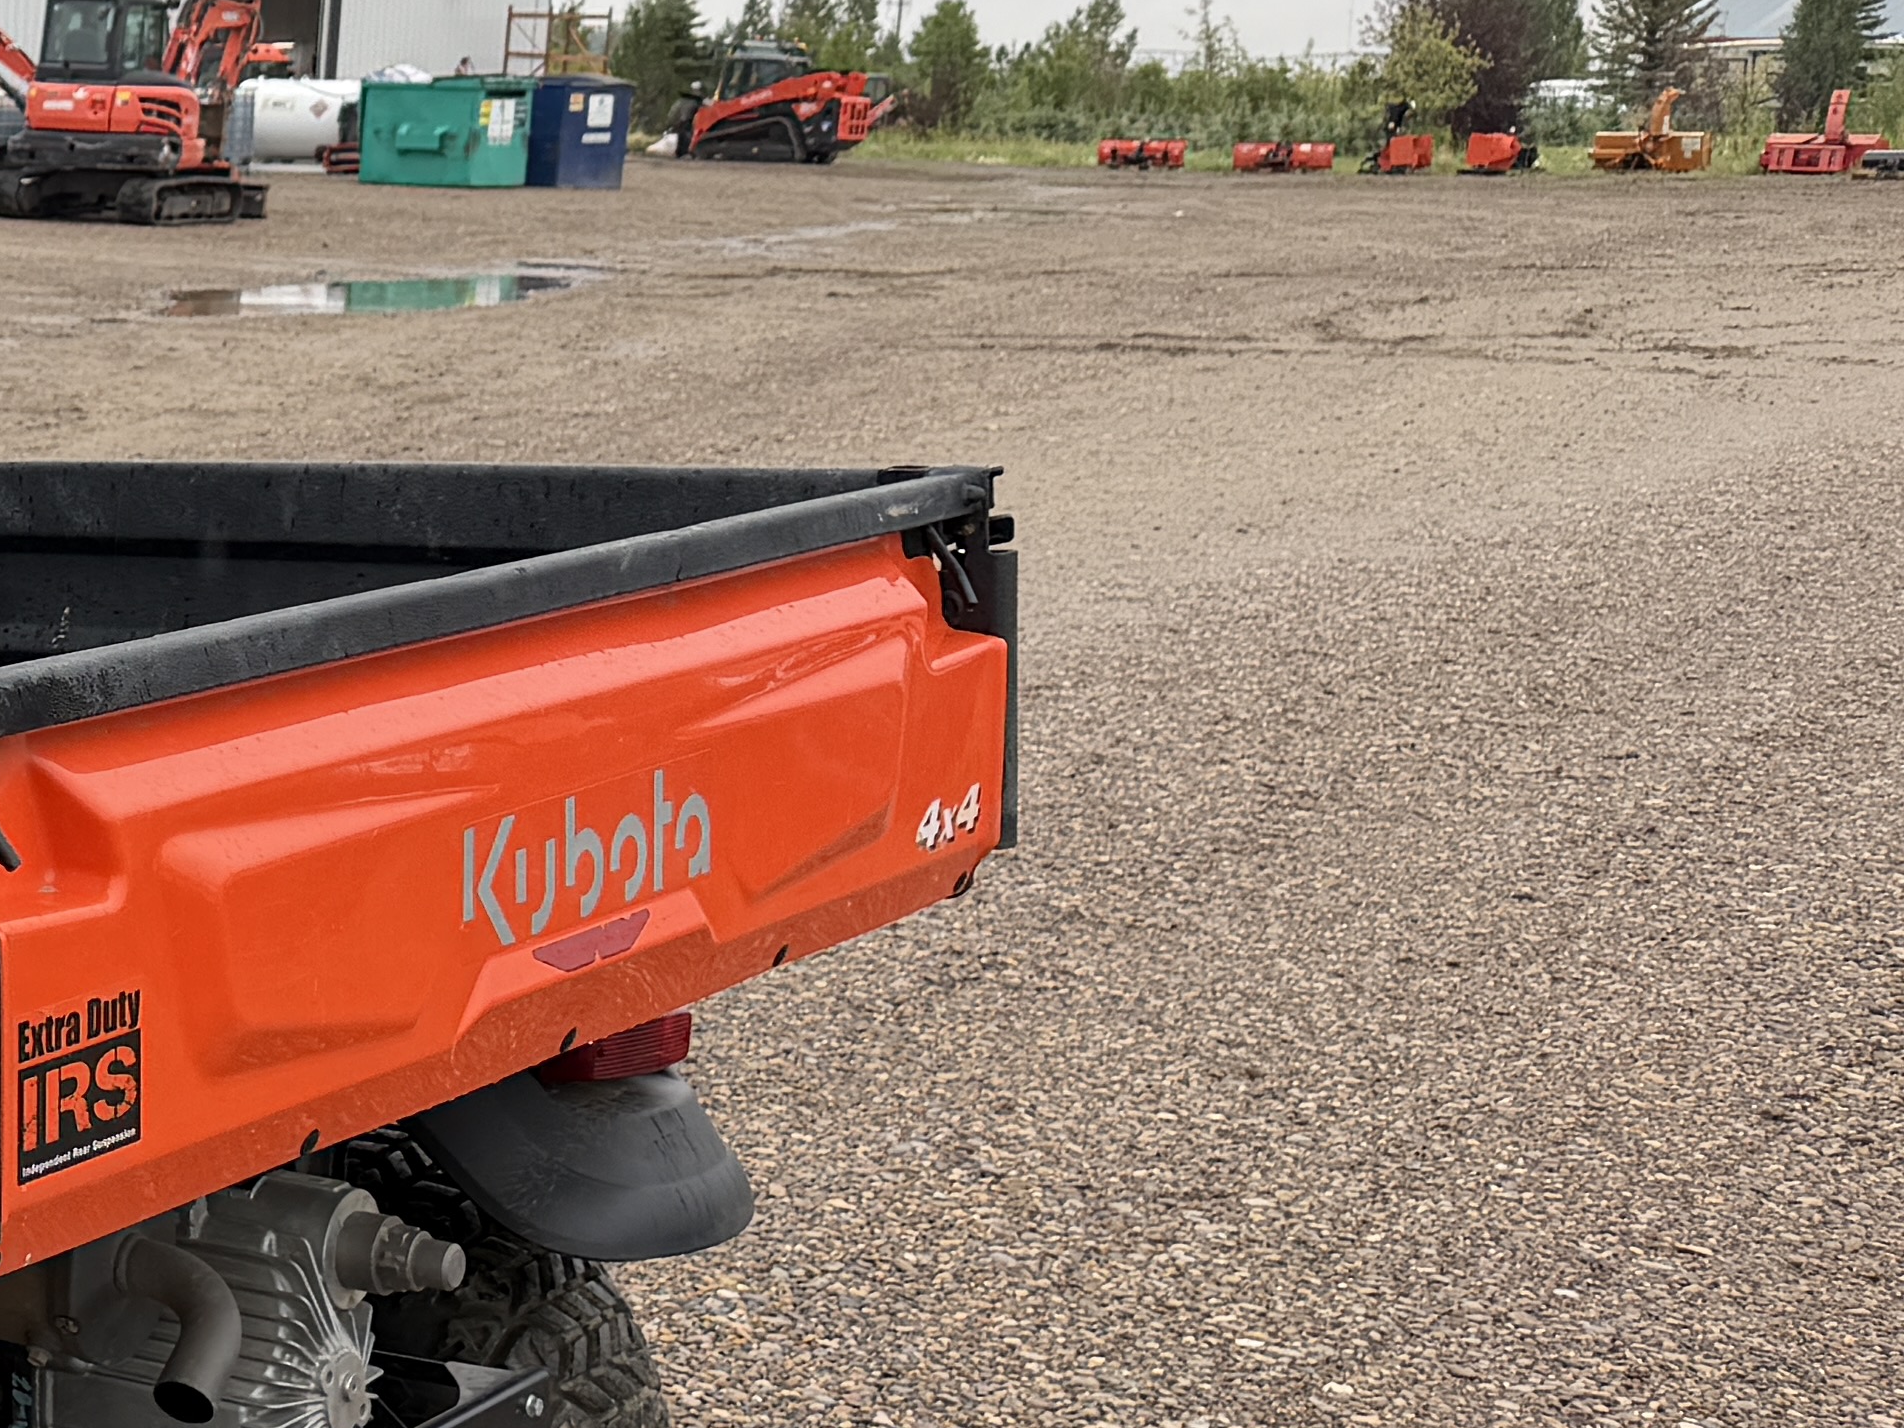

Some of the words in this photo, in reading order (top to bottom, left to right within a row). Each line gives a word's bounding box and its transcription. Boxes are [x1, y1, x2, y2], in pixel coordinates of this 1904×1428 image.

[463, 769, 711, 946] Kubota
[915, 782, 981, 852] 4x4
[18, 1011, 80, 1064] Extra
[87, 989, 141, 1039] Duty
[23, 1046, 138, 1152] IRS
